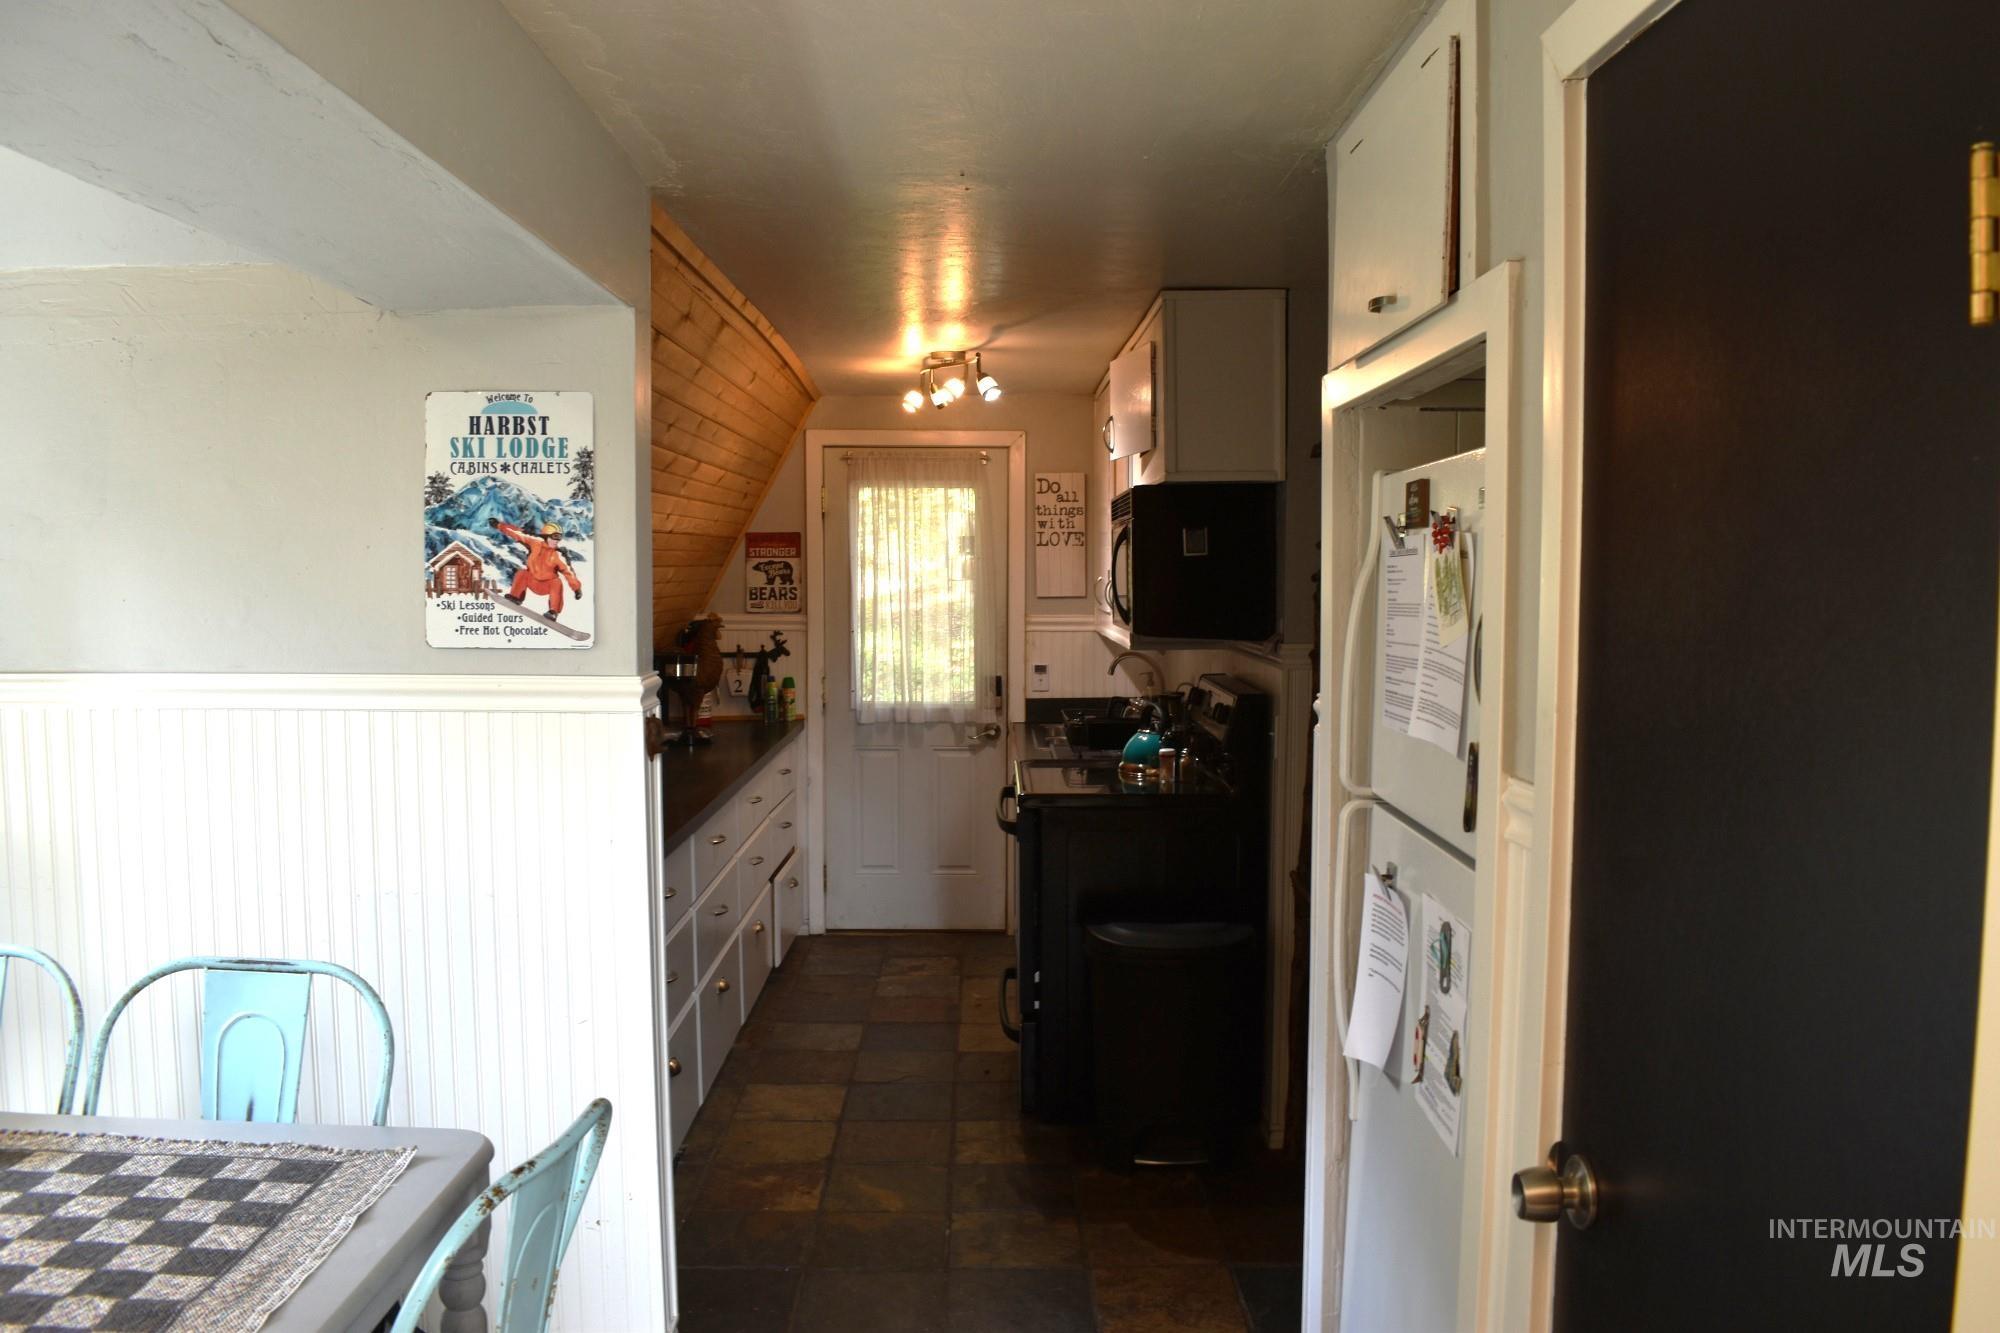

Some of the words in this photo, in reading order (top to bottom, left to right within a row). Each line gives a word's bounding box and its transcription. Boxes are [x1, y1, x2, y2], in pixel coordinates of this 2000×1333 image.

[486, 393, 521, 404] Welcome
[523, 393, 534, 404] To
[469, 416, 550, 435] HARBST
[450, 437, 485, 458] SKI
[496, 437, 569, 458] LODGE
[450, 461, 498, 475] CABINS
[512, 461, 571, 475] CHALETS
[1036, 478, 1061, 494] Do
[1056, 491, 1079, 503] all
[1036, 504, 1084, 518] things
[1037, 518, 1075, 529] with
[1036, 531, 1085, 547] LOVE
[749, 547, 797, 557] STRONGER
[749, 587, 798, 601] BEARS
[441, 600, 455, 612] Ski
[459, 601, 495, 612] Lessons
[462, 613, 493, 623] Guided
[497, 613, 524, 623] Tours
[460, 625, 480, 636] Free
[483, 625, 499, 636] Hot
[503, 625, 548, 636] Chocolate
[734, 679, 743, 693] 2
